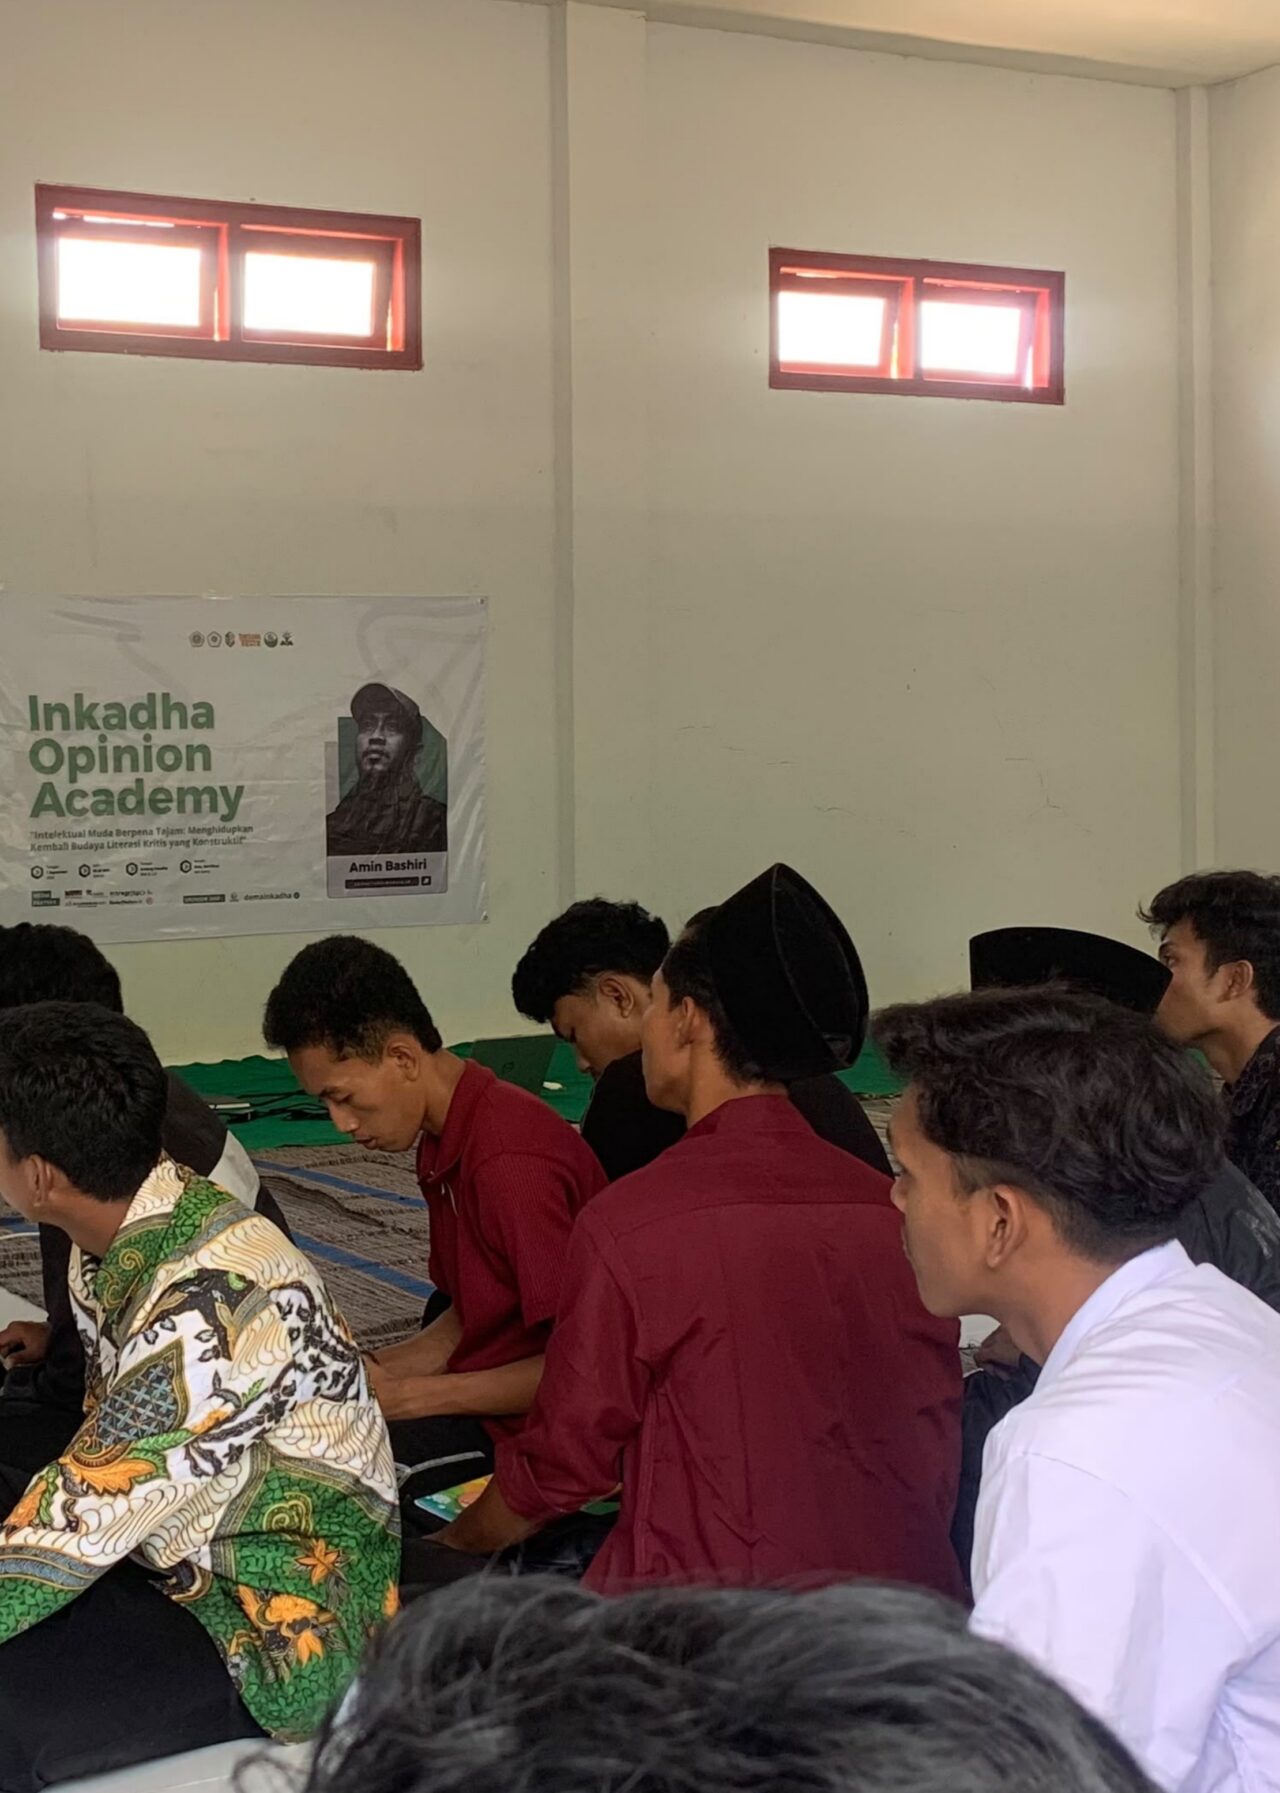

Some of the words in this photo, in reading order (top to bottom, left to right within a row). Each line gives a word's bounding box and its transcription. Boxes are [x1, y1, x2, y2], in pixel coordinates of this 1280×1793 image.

[29, 692, 215, 731] Inkadha
[29, 733, 212, 784] Opinion
[29, 778, 245, 822] Academy
[88, 828, 114, 838] Muda
[115, 828, 154, 838] Berpena
[188, 824, 254, 836] Menghidupkan
[30, 842, 69, 851] Kembali
[71, 840, 105, 852] Budaya
[107, 839, 141, 849] Literasi
[143, 838, 168, 848] Kritis
[169, 840, 191, 849] yang
[349, 861, 382, 873] Amin
[385, 858, 427, 871] Bashiri
